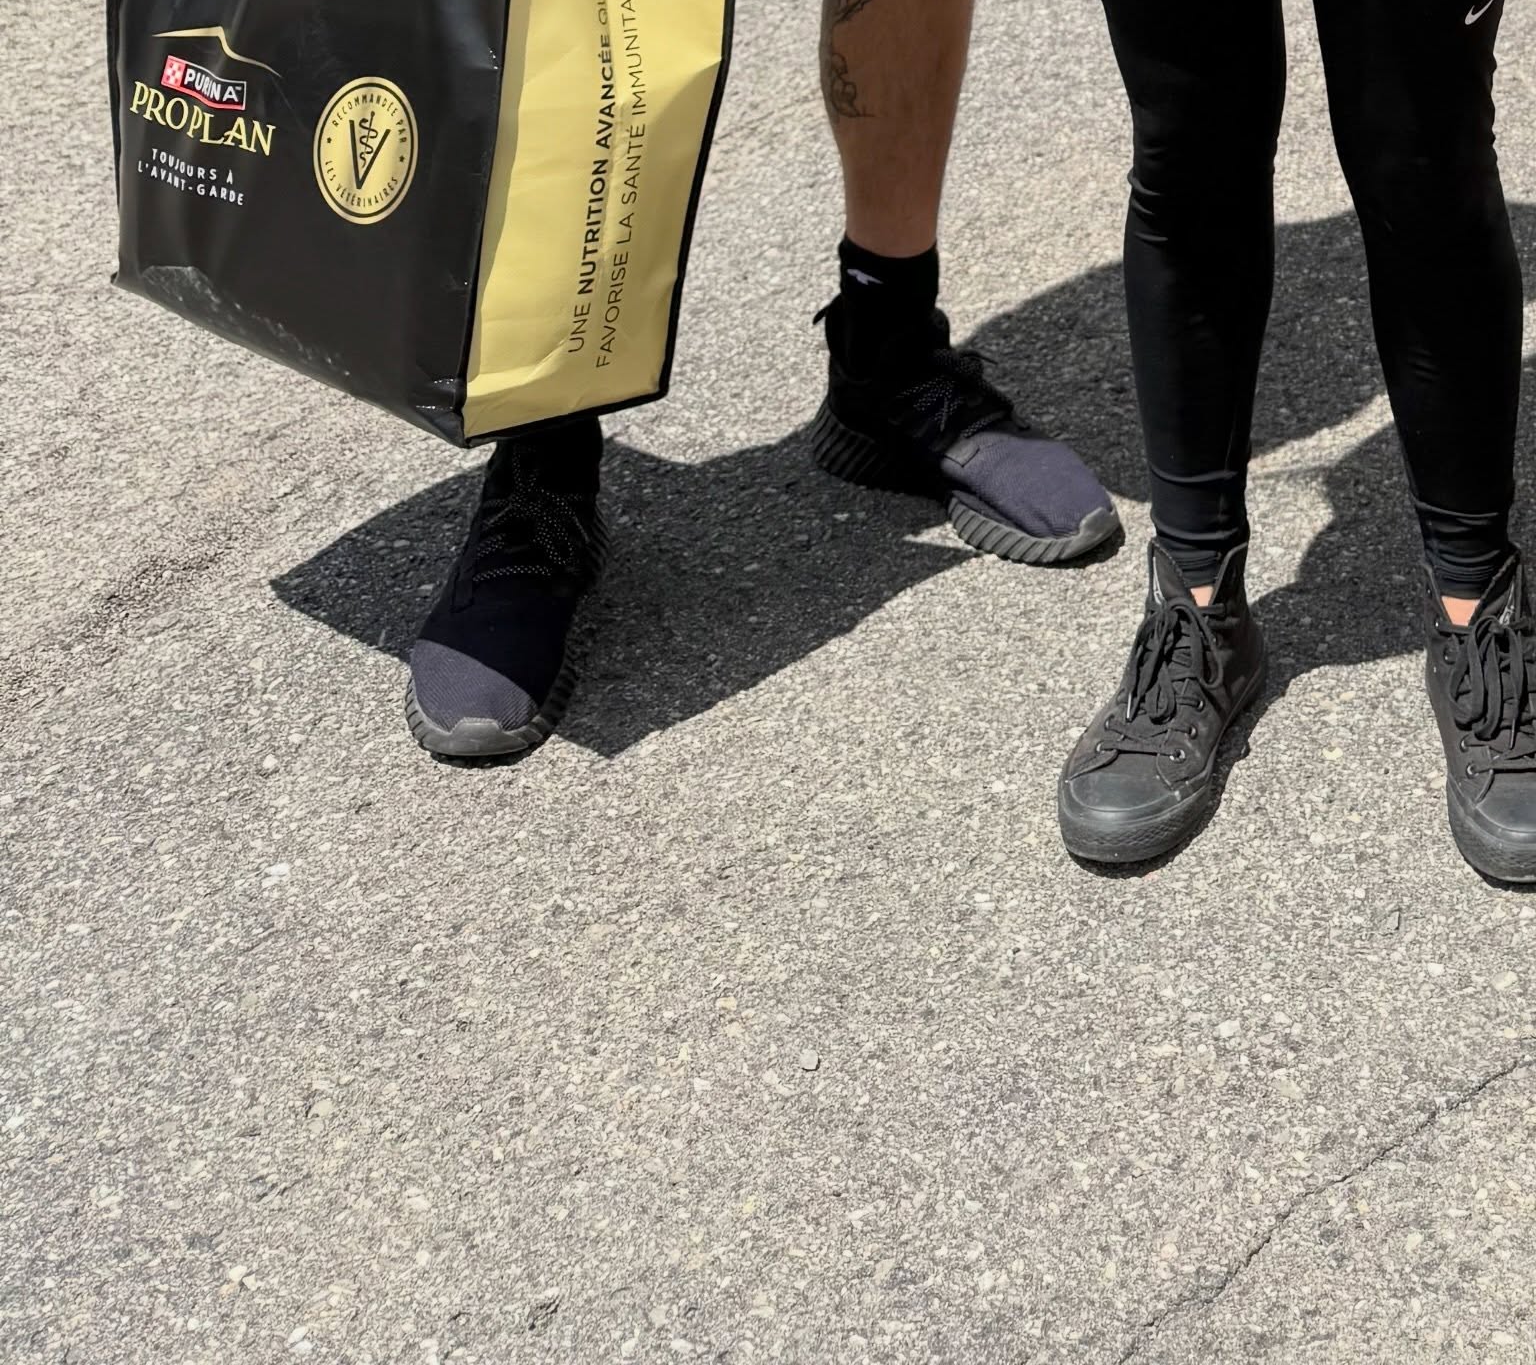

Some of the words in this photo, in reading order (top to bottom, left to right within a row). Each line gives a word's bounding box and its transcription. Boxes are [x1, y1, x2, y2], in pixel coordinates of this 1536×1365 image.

[183, 68, 240, 103] PURINA
[596, 34, 616, 149] AVANCÉE
[137, 160, 245, 206] L'AVANT-GARDE
[152, 147, 218, 181] TOUJOURS
[621, 123, 646, 205] SANTÉ
[577, 158, 609, 295] NUTRITION
[616, 212, 634, 244] LA
[568, 302, 591, 353] UNE
[596, 251, 629, 368] FAVORISE
